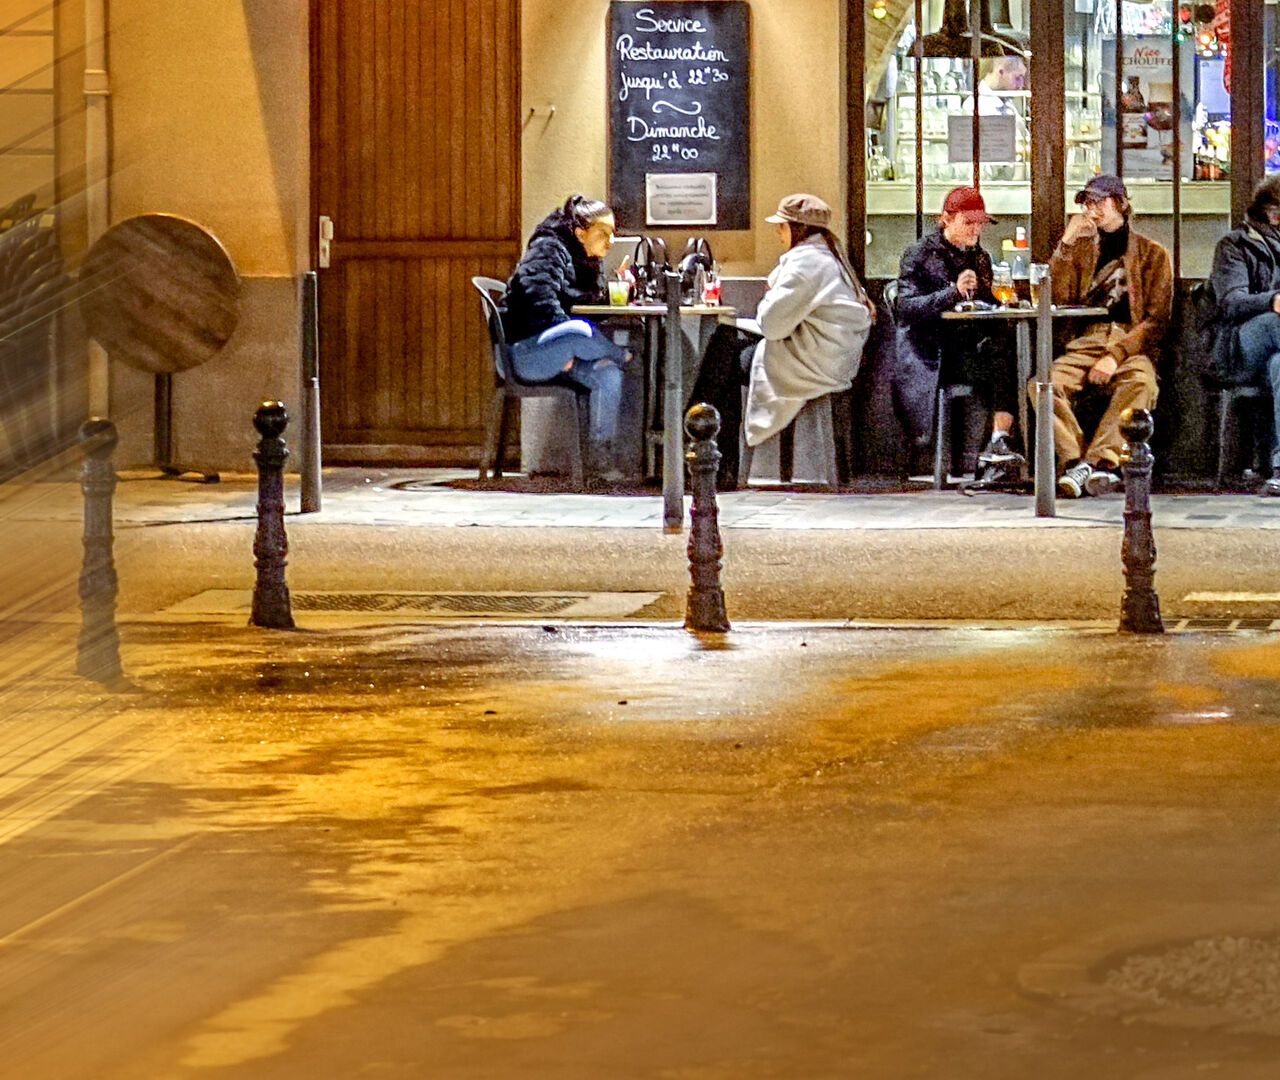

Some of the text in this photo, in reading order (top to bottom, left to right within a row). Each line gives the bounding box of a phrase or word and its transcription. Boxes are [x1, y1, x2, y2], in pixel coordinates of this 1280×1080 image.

[636, 8, 707, 33] Service
[616, 34, 729, 61] Restauration
[627, 116, 720, 141] Dimanche
